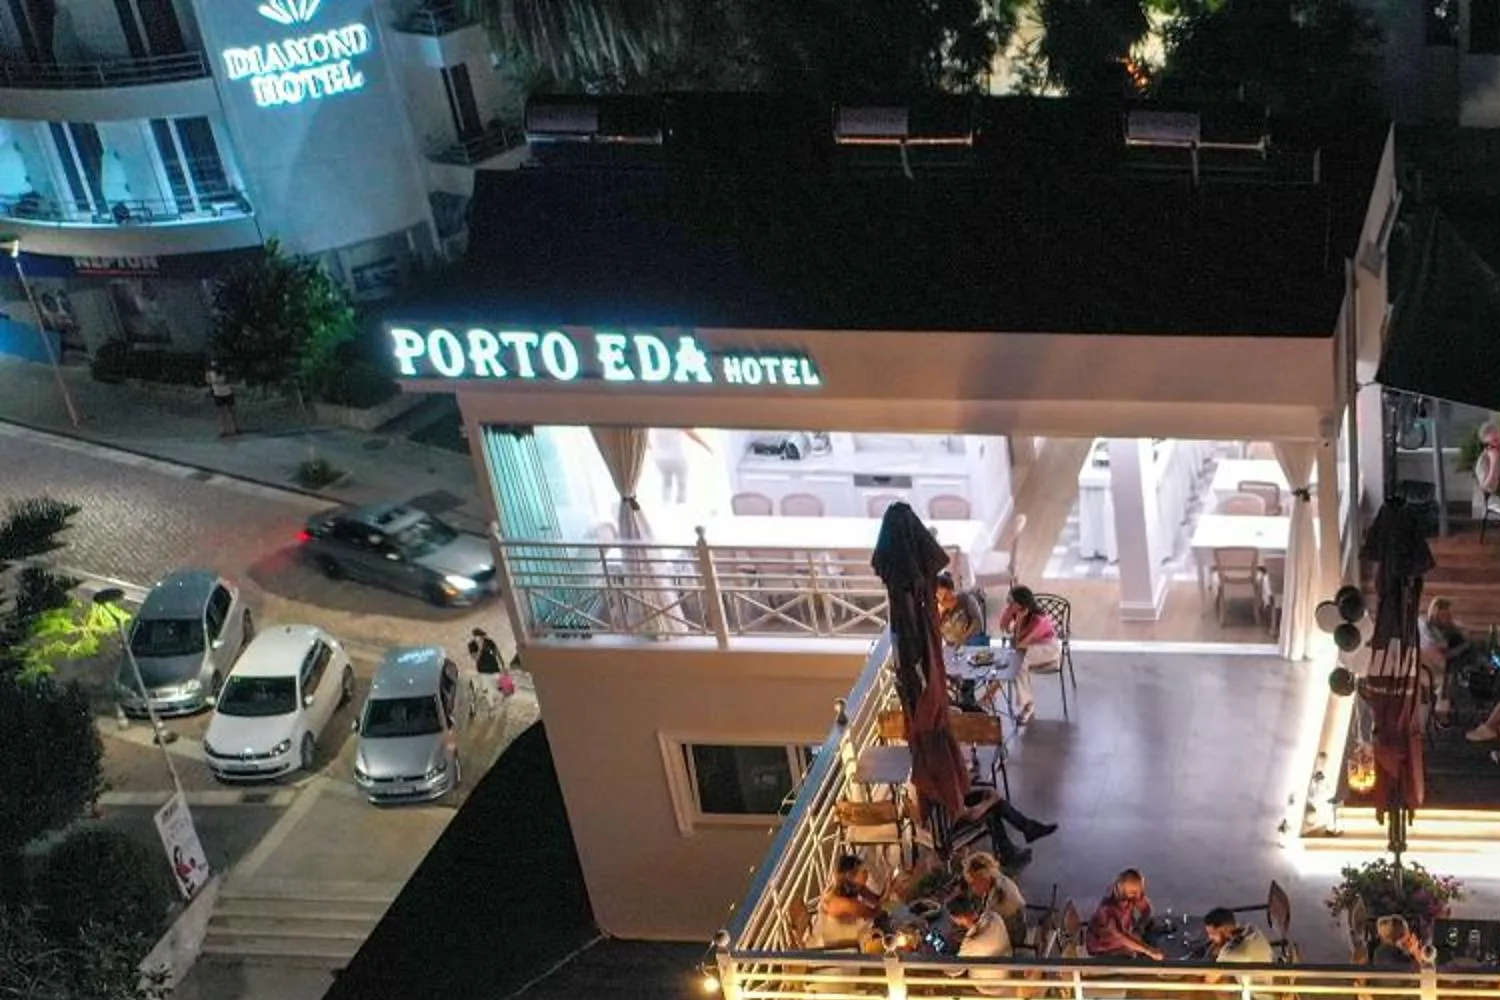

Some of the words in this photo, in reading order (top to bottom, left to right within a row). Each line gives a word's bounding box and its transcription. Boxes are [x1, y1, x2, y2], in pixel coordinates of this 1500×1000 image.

[223, 23, 371, 80] DIAMOND
[251, 59, 365, 107] HOTEL
[390, 328, 579, 382] PORTO
[595, 333, 712, 383] EDA
[723, 355, 822, 385] HOTEL
